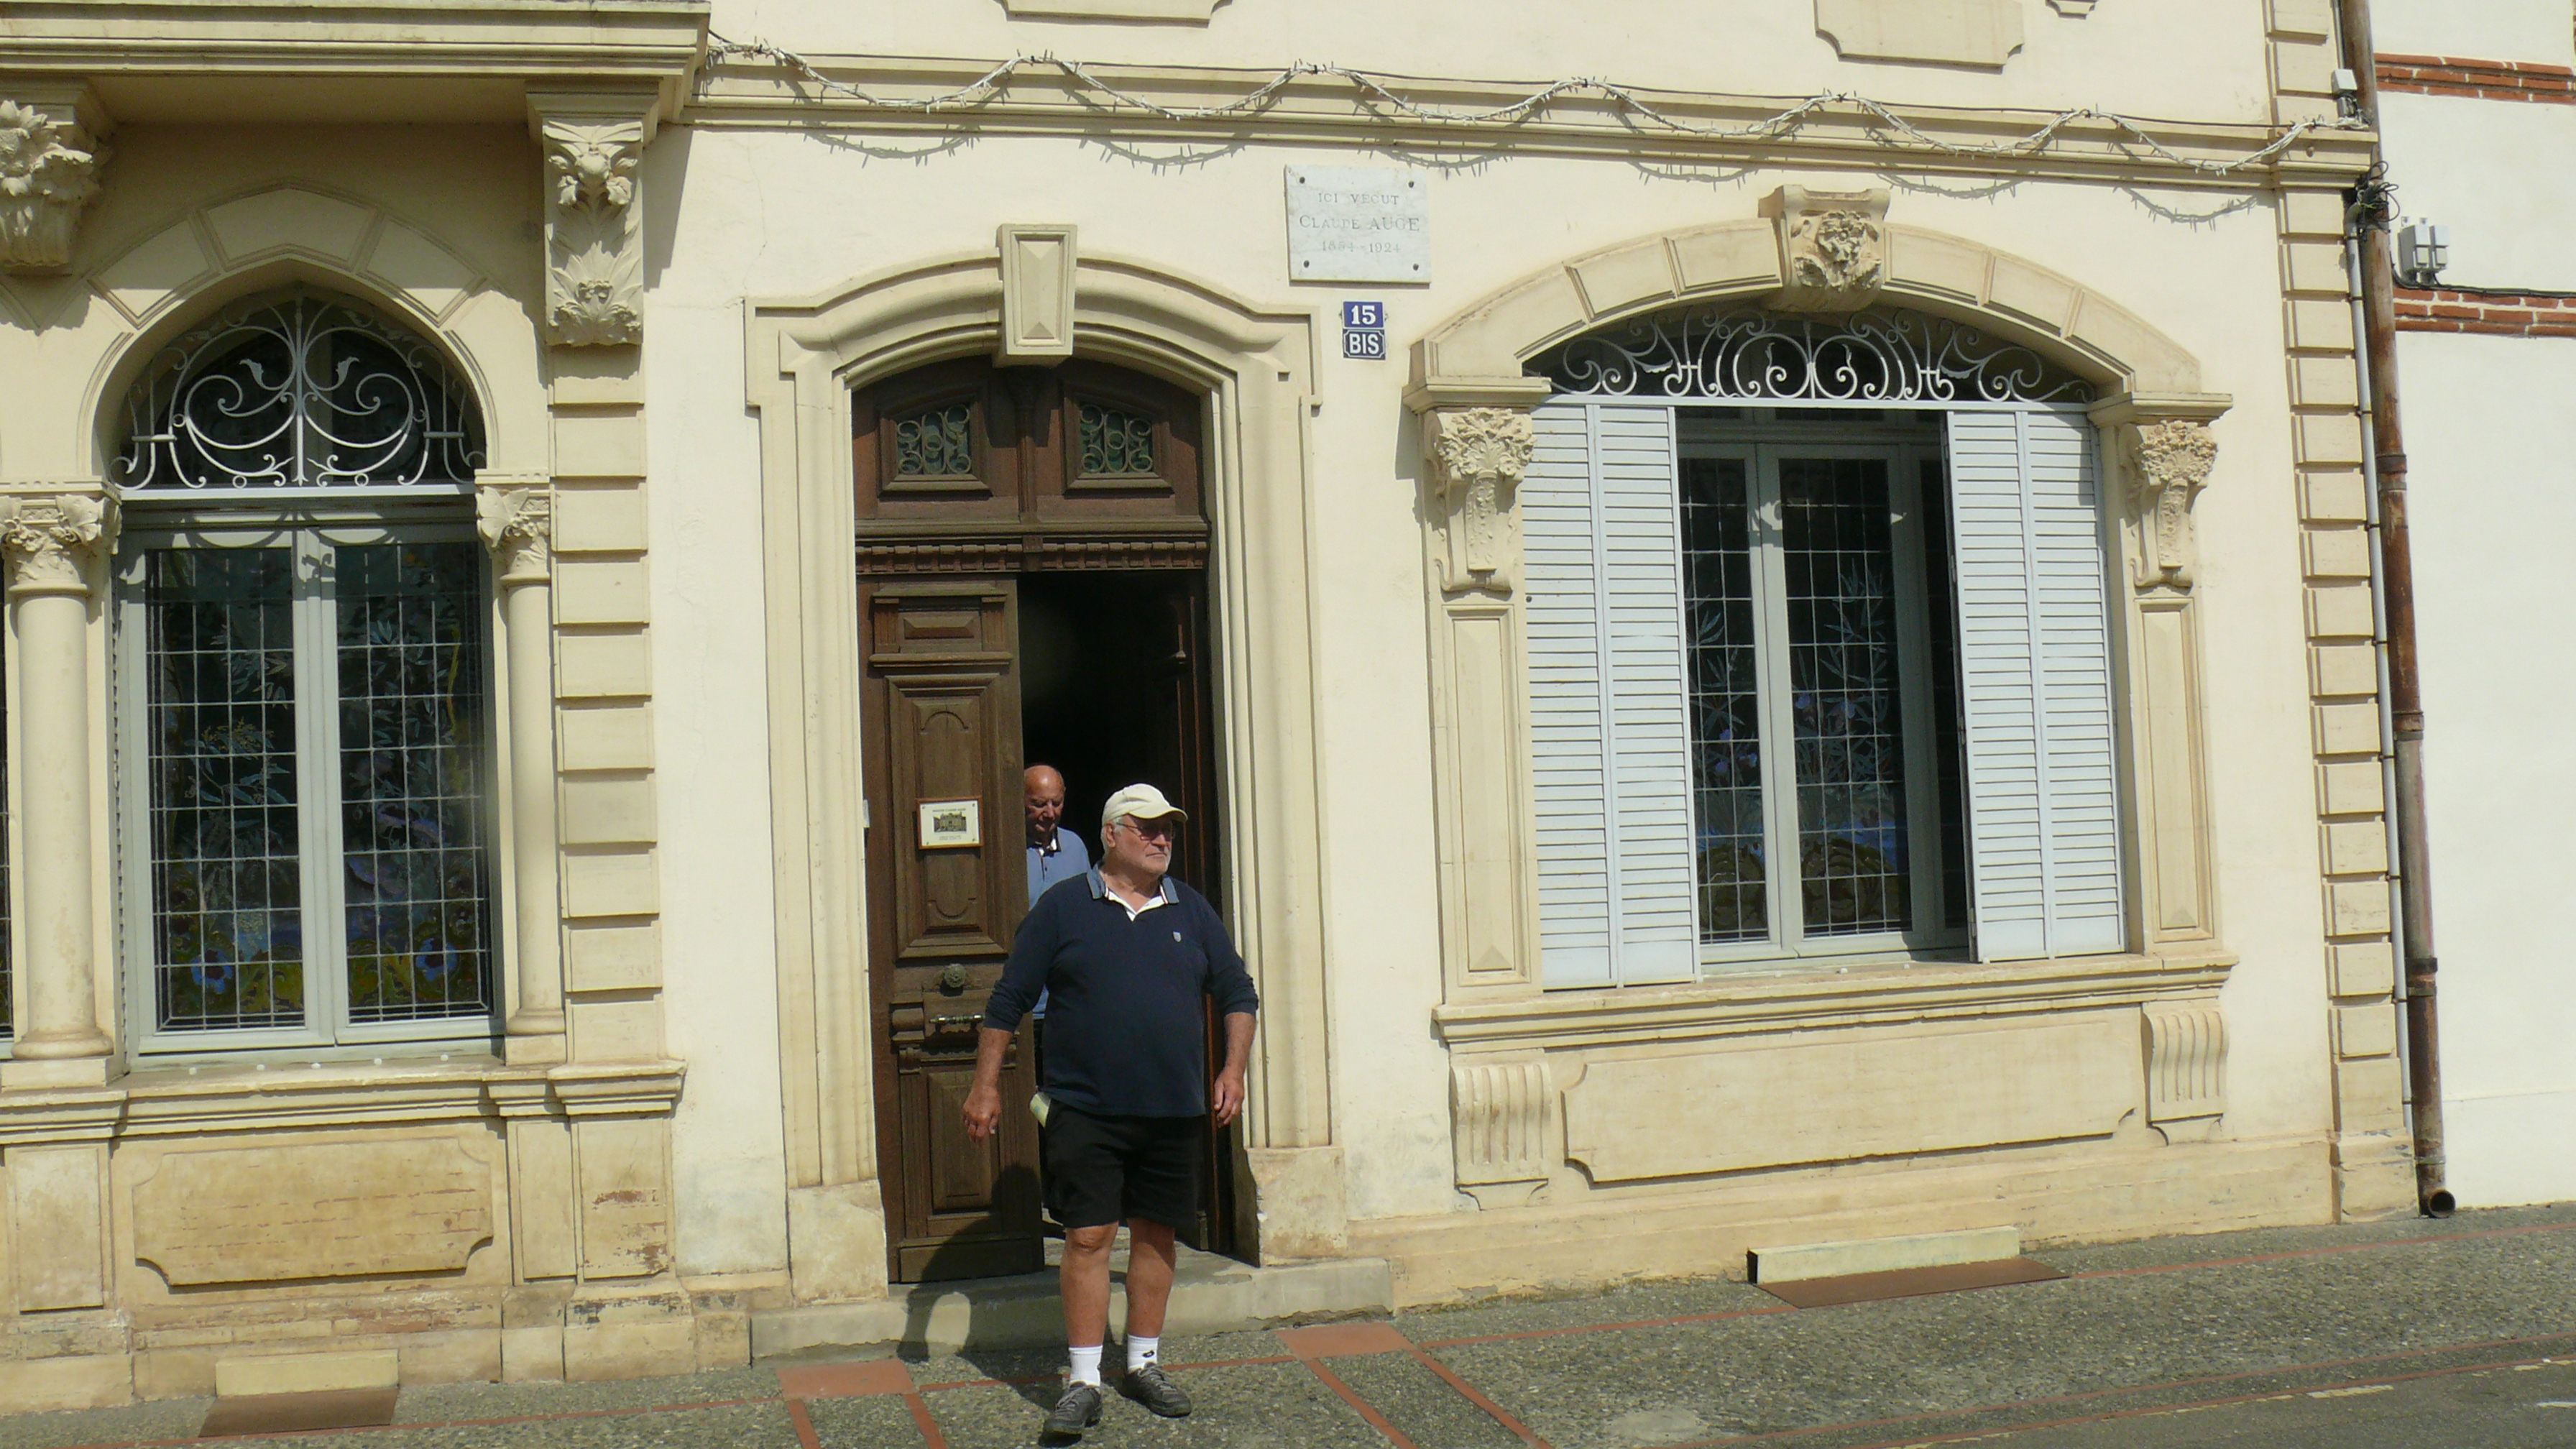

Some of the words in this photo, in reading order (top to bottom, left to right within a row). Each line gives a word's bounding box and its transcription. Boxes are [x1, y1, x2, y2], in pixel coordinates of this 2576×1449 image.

[1318, 193, 1338, 203] ICI
[1351, 193, 1399, 205] VECUT
[1299, 214, 1361, 230] CLAUDE
[1351, 305, 1376, 325] 15
[1349, 333, 1379, 354] BIS
